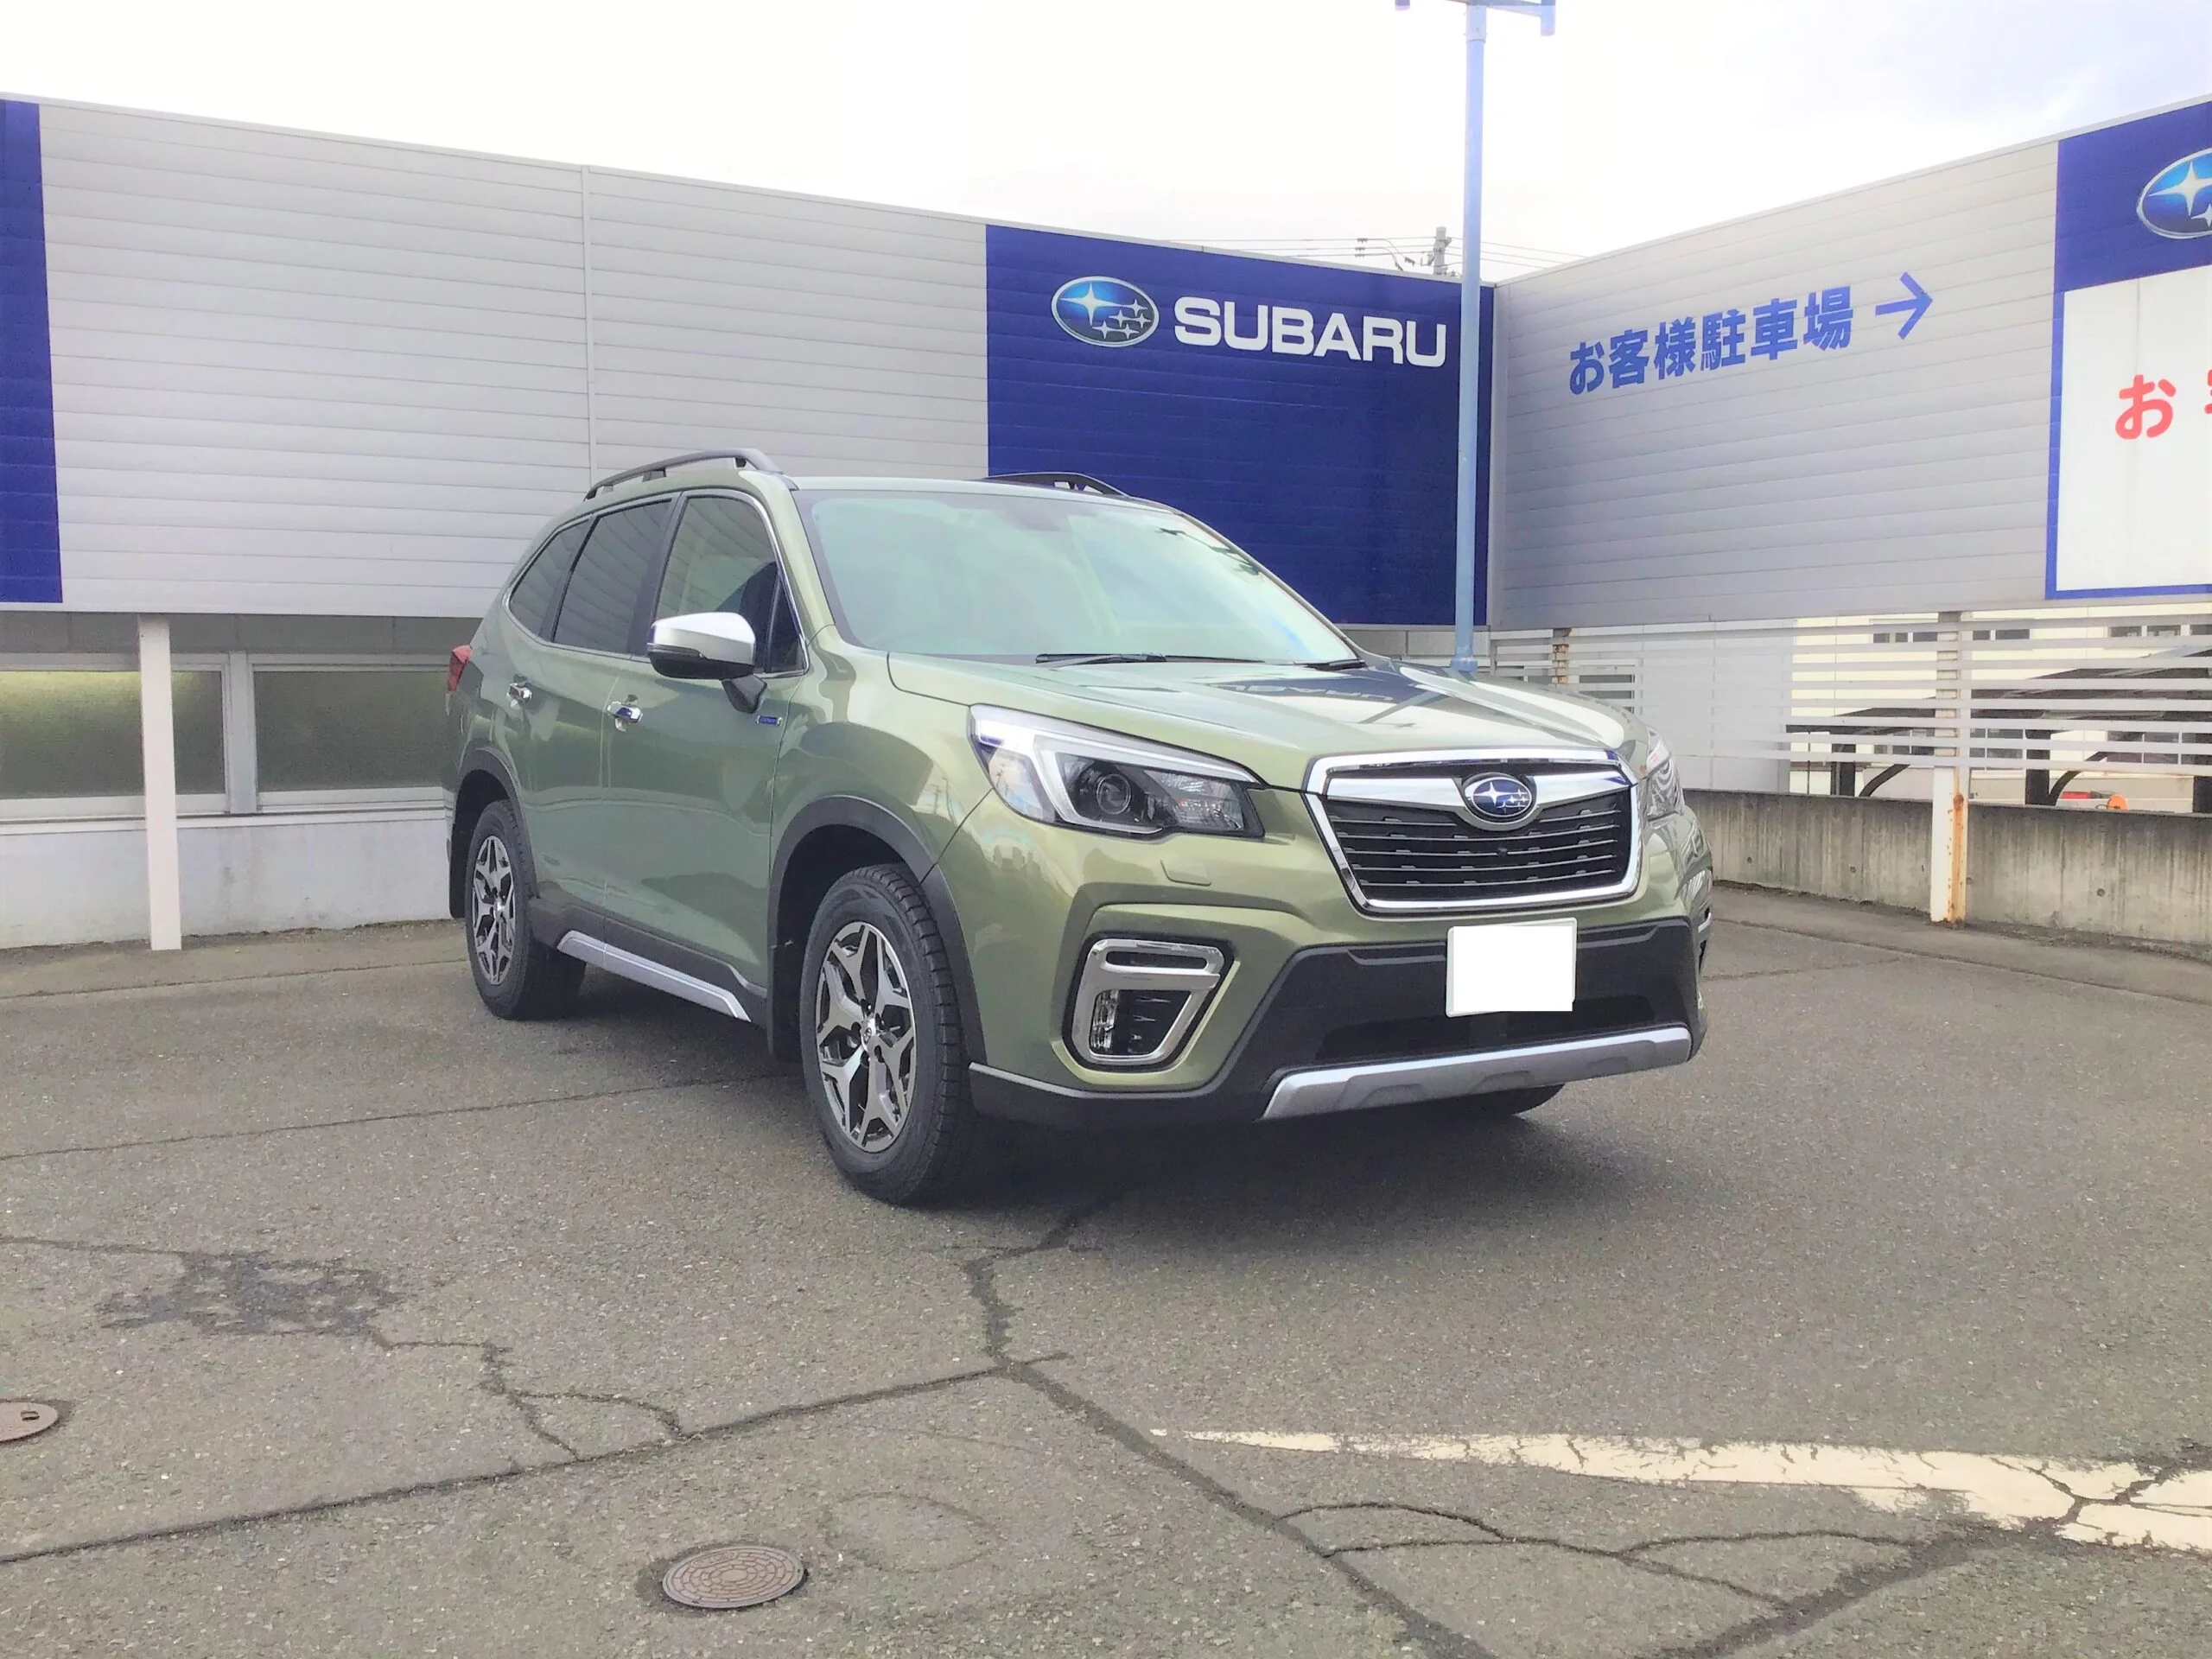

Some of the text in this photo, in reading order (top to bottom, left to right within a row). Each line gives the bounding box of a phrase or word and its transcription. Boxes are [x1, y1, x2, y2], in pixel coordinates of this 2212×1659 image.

[1173, 296, 1447, 368] SUBARU
[1569, 285, 1854, 395] お客様駐車場
[2115, 369, 2212, 440] お
